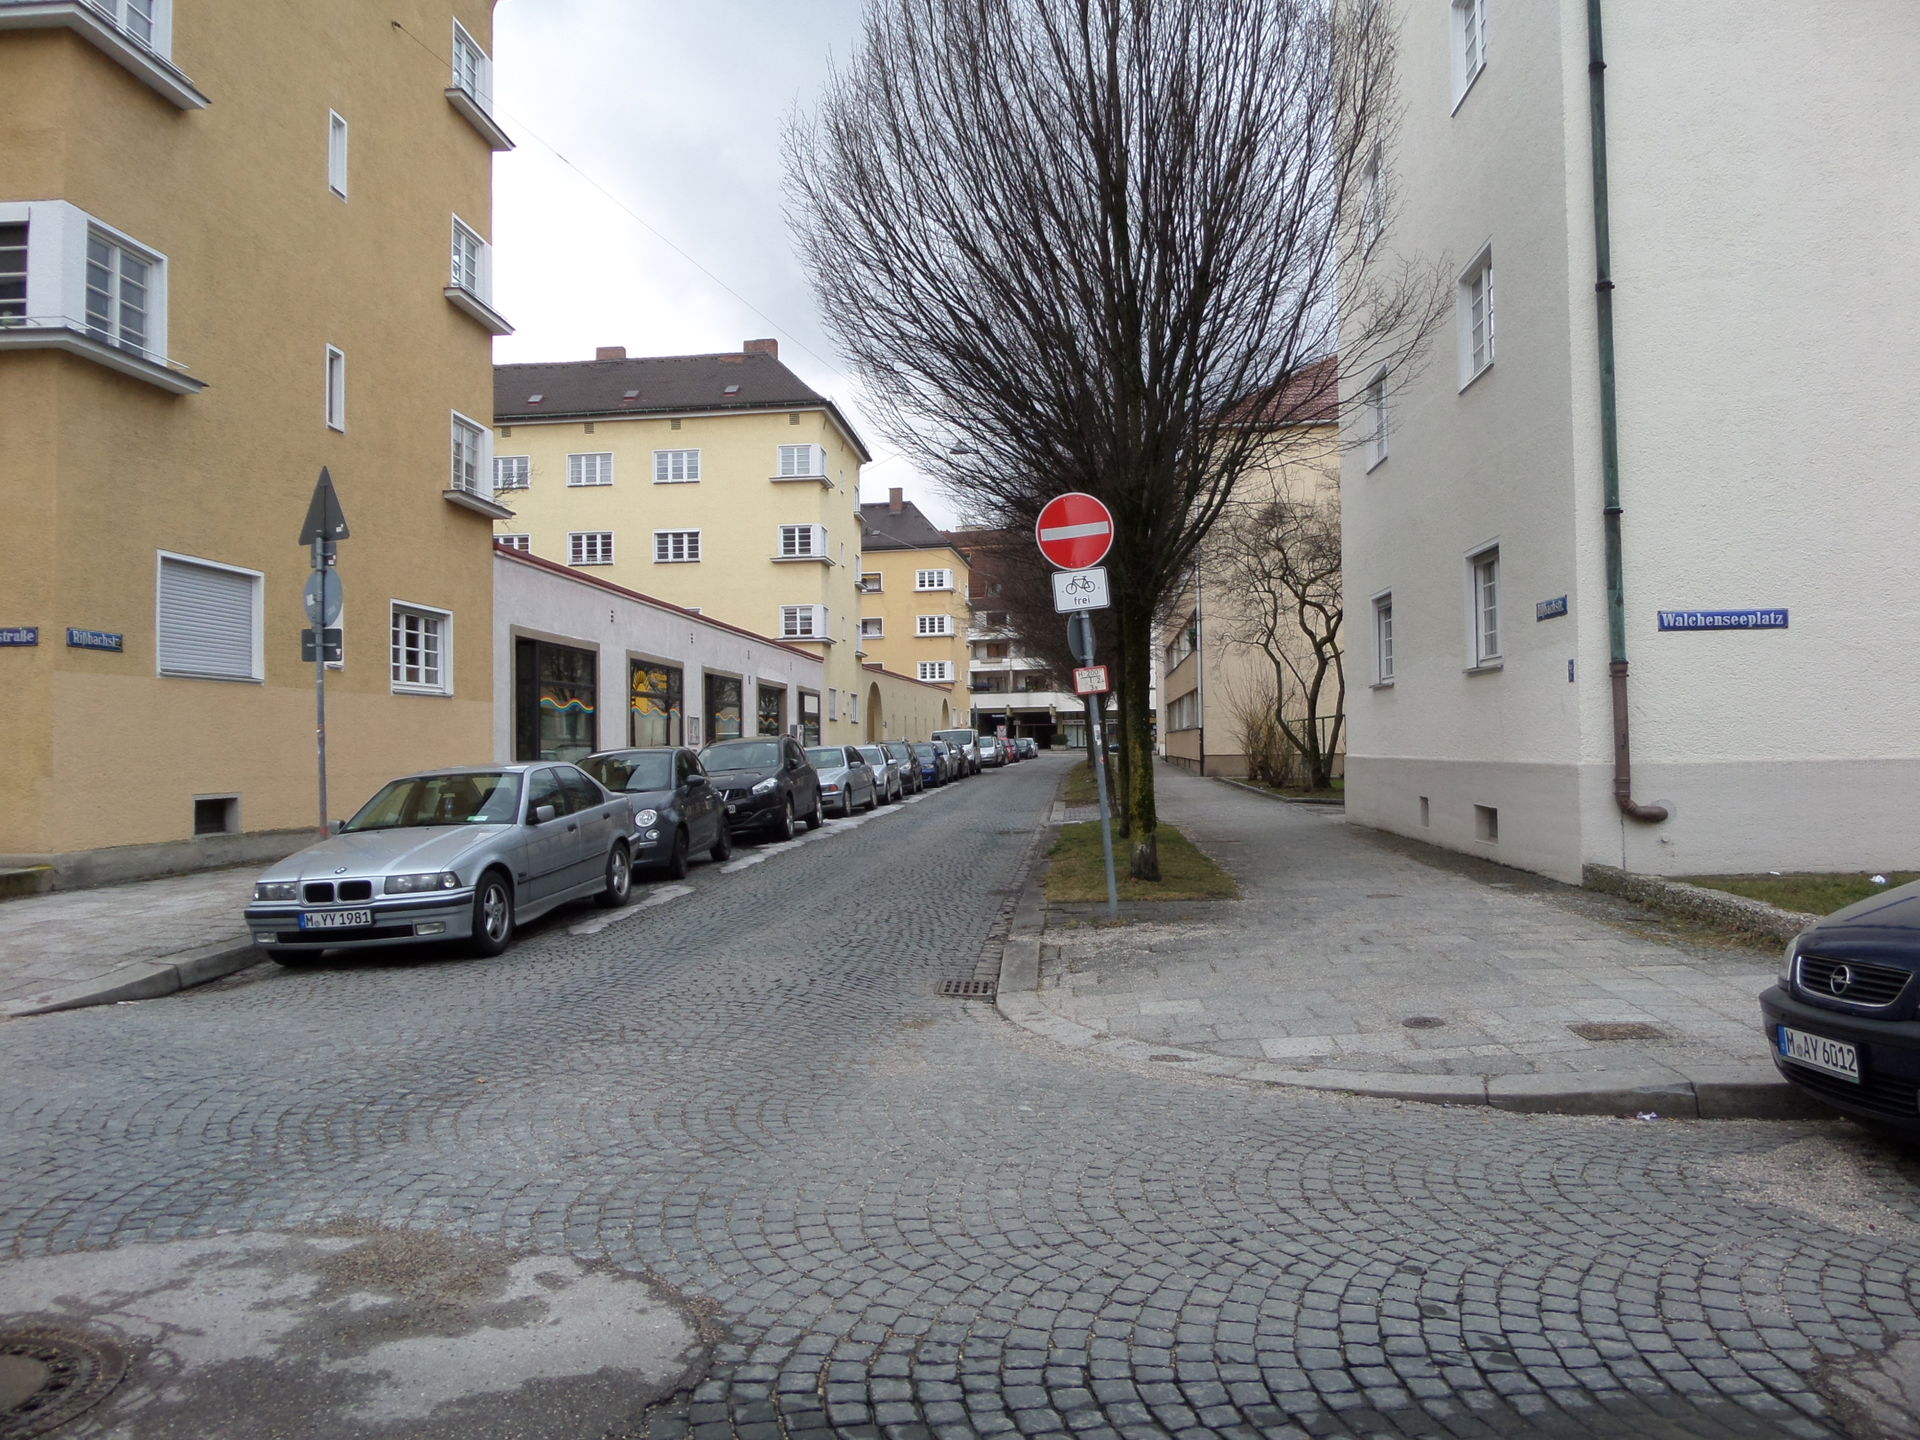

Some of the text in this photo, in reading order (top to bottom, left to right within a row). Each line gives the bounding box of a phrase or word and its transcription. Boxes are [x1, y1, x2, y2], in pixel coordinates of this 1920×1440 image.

[1074, 595, 1091, 605] frei
[1661, 611, 1784, 627] Walchenseeplatz
[305, 911, 370, 927] M YY 1981
[1785, 1030, 1857, 1073] M AY 6012
